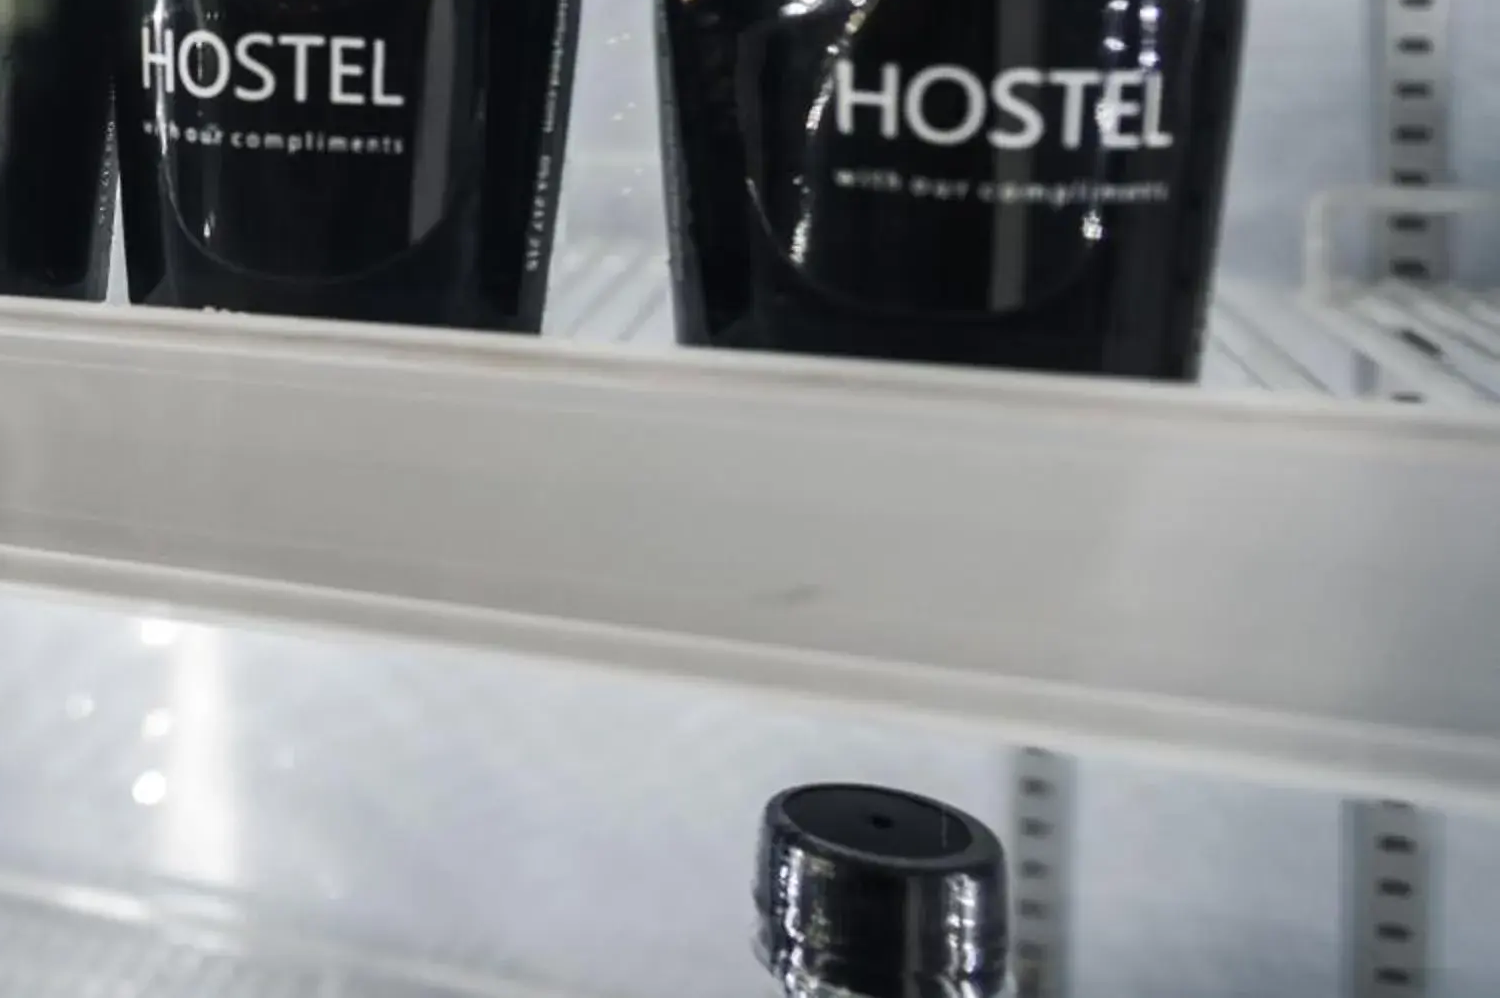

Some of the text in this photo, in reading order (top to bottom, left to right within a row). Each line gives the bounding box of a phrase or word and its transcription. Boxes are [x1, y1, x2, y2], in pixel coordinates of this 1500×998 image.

[141, 25, 405, 106] HOSTEL
[835, 57, 1174, 150] HOSTEL
[143, 120, 180, 141] wh
[230, 130, 404, 154] compliments
